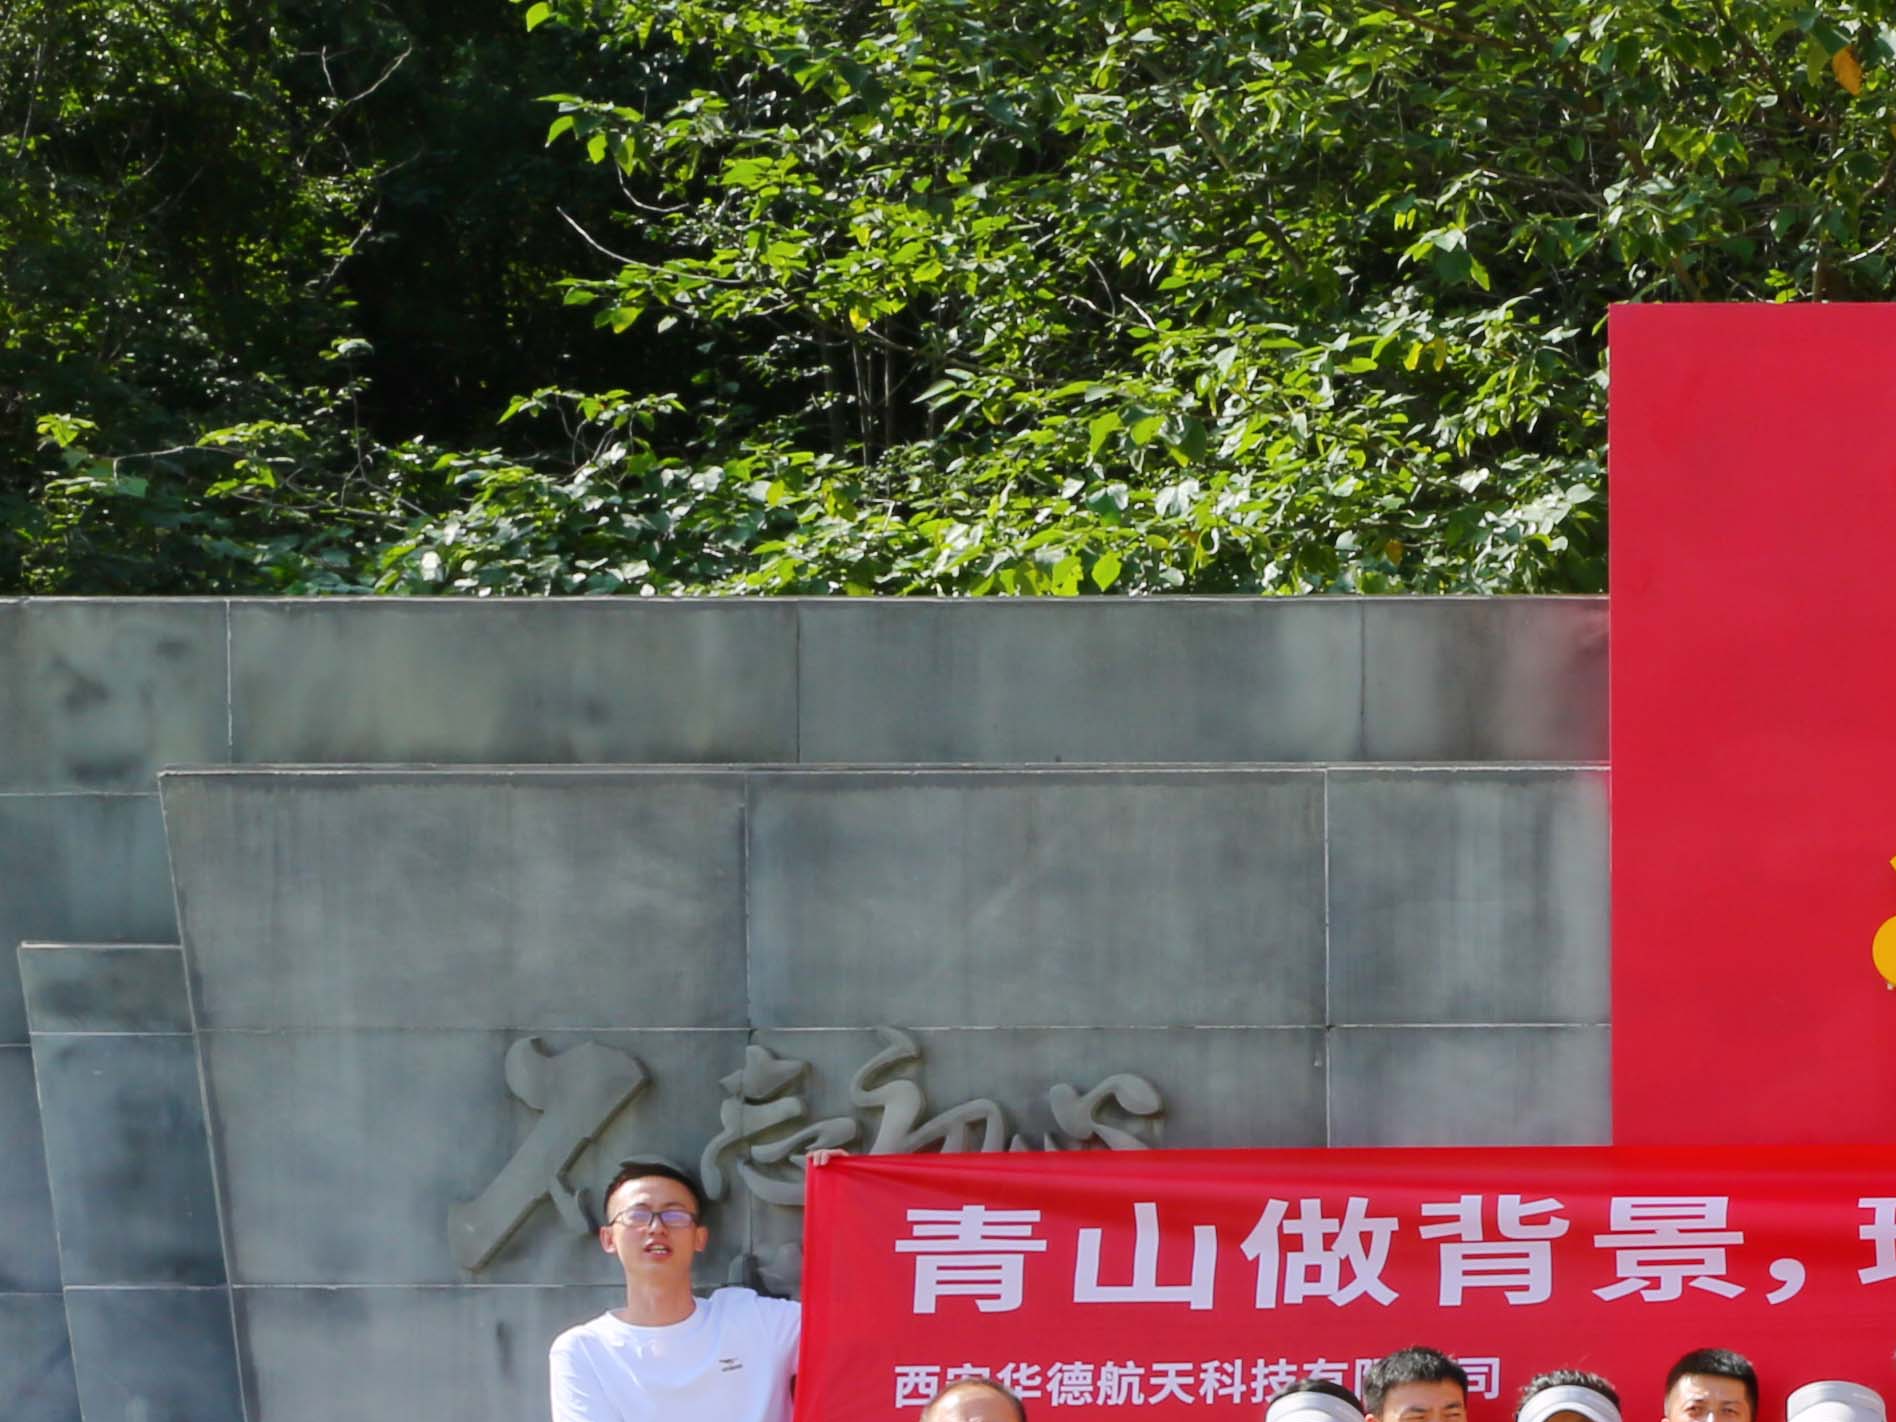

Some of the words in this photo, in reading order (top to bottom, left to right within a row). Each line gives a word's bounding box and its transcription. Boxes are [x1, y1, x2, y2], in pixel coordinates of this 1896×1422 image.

[894, 1356, 1501, 1408] 西华德航天科技有司
